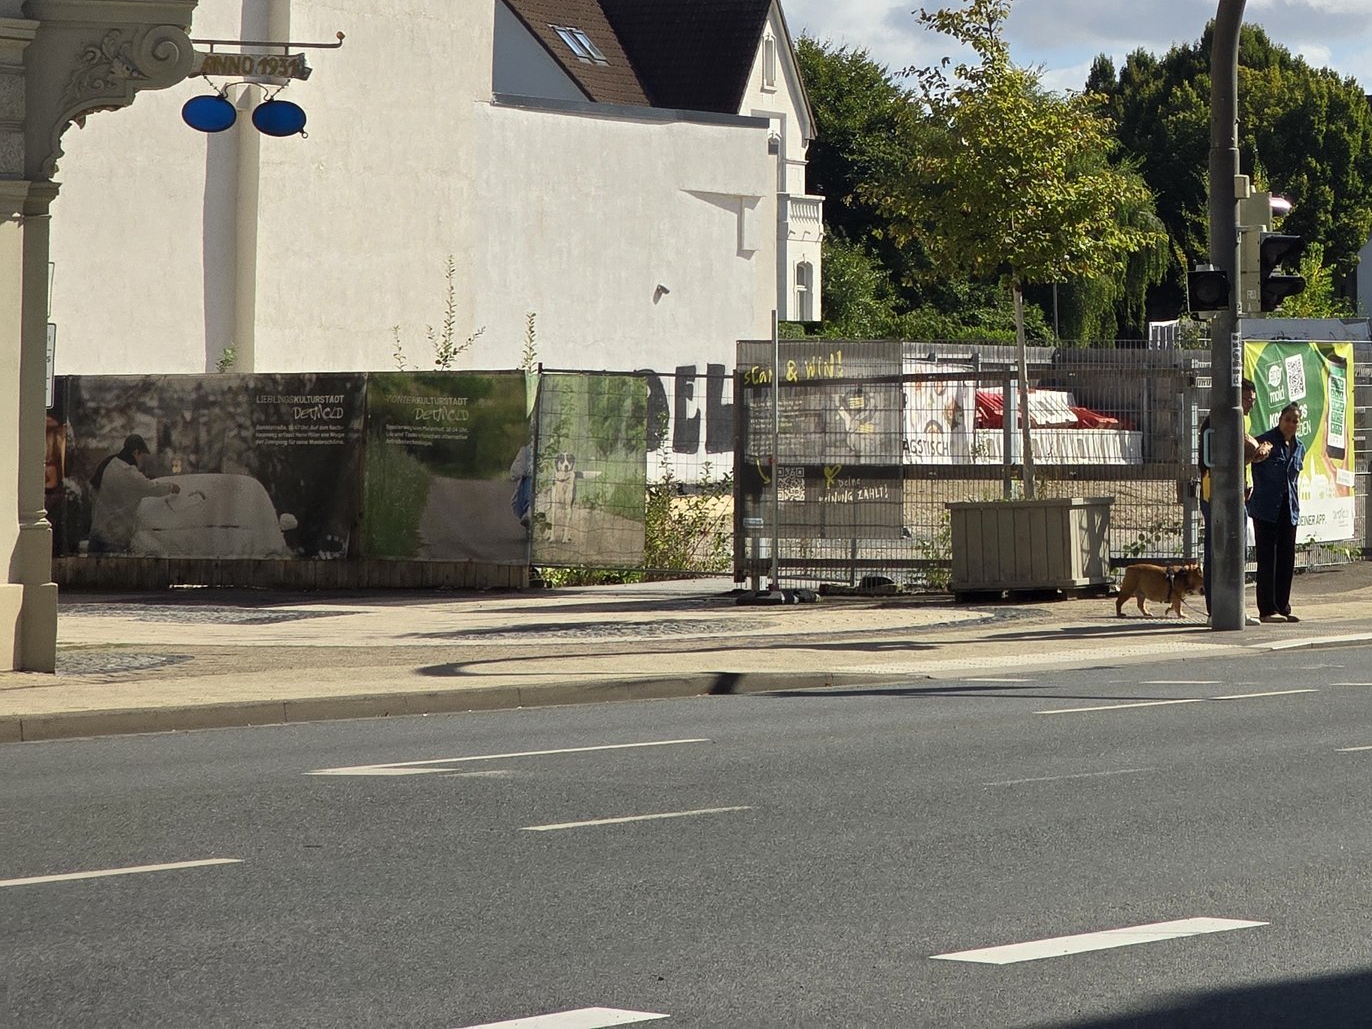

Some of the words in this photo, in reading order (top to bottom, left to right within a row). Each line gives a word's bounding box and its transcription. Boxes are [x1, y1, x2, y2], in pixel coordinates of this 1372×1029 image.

[203, 55, 254, 75] ANNO
[258, 56, 298, 77] 1931
[786, 359, 798, 382] &
[256, 394, 345, 404] LIEBLINGSKULTURSTADT
[1270, 387, 1285, 403] mold
